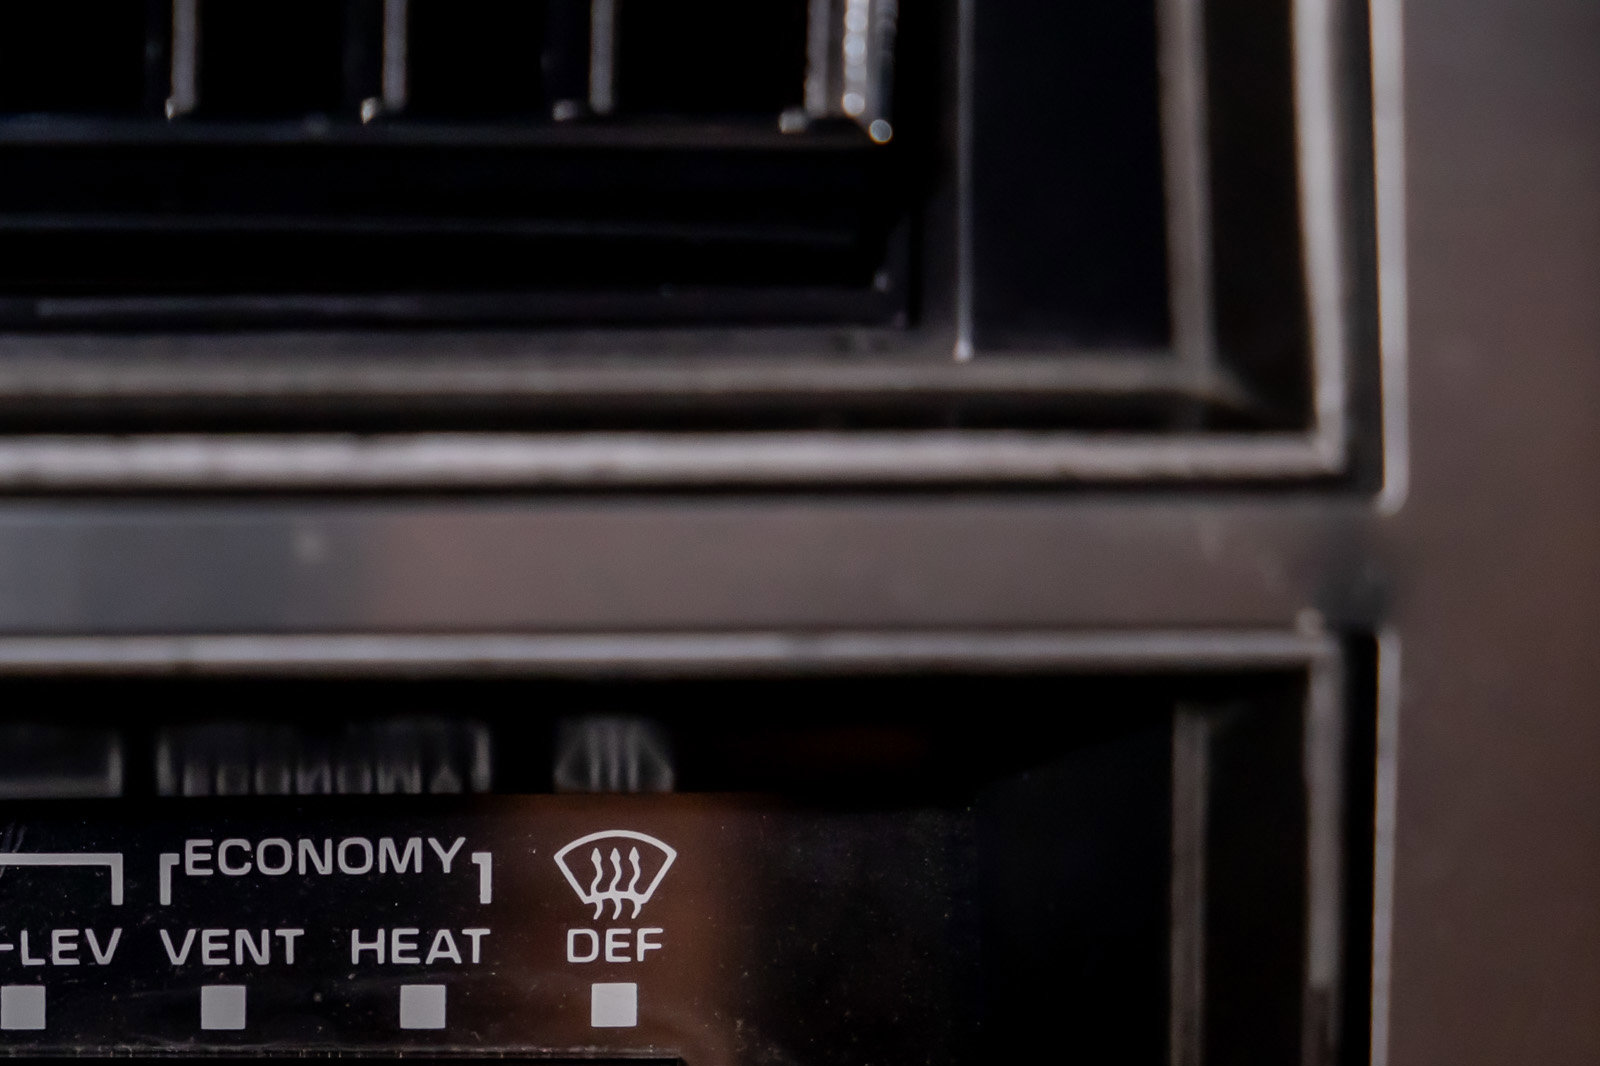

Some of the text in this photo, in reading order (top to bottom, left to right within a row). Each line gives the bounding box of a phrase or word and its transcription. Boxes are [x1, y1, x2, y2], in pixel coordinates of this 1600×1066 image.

[184, 837, 467, 876] ECONOMY
[158, 927, 306, 966] VENT
[350, 927, 492, 966] HEAT
[565, 926, 665, 964] DEF
